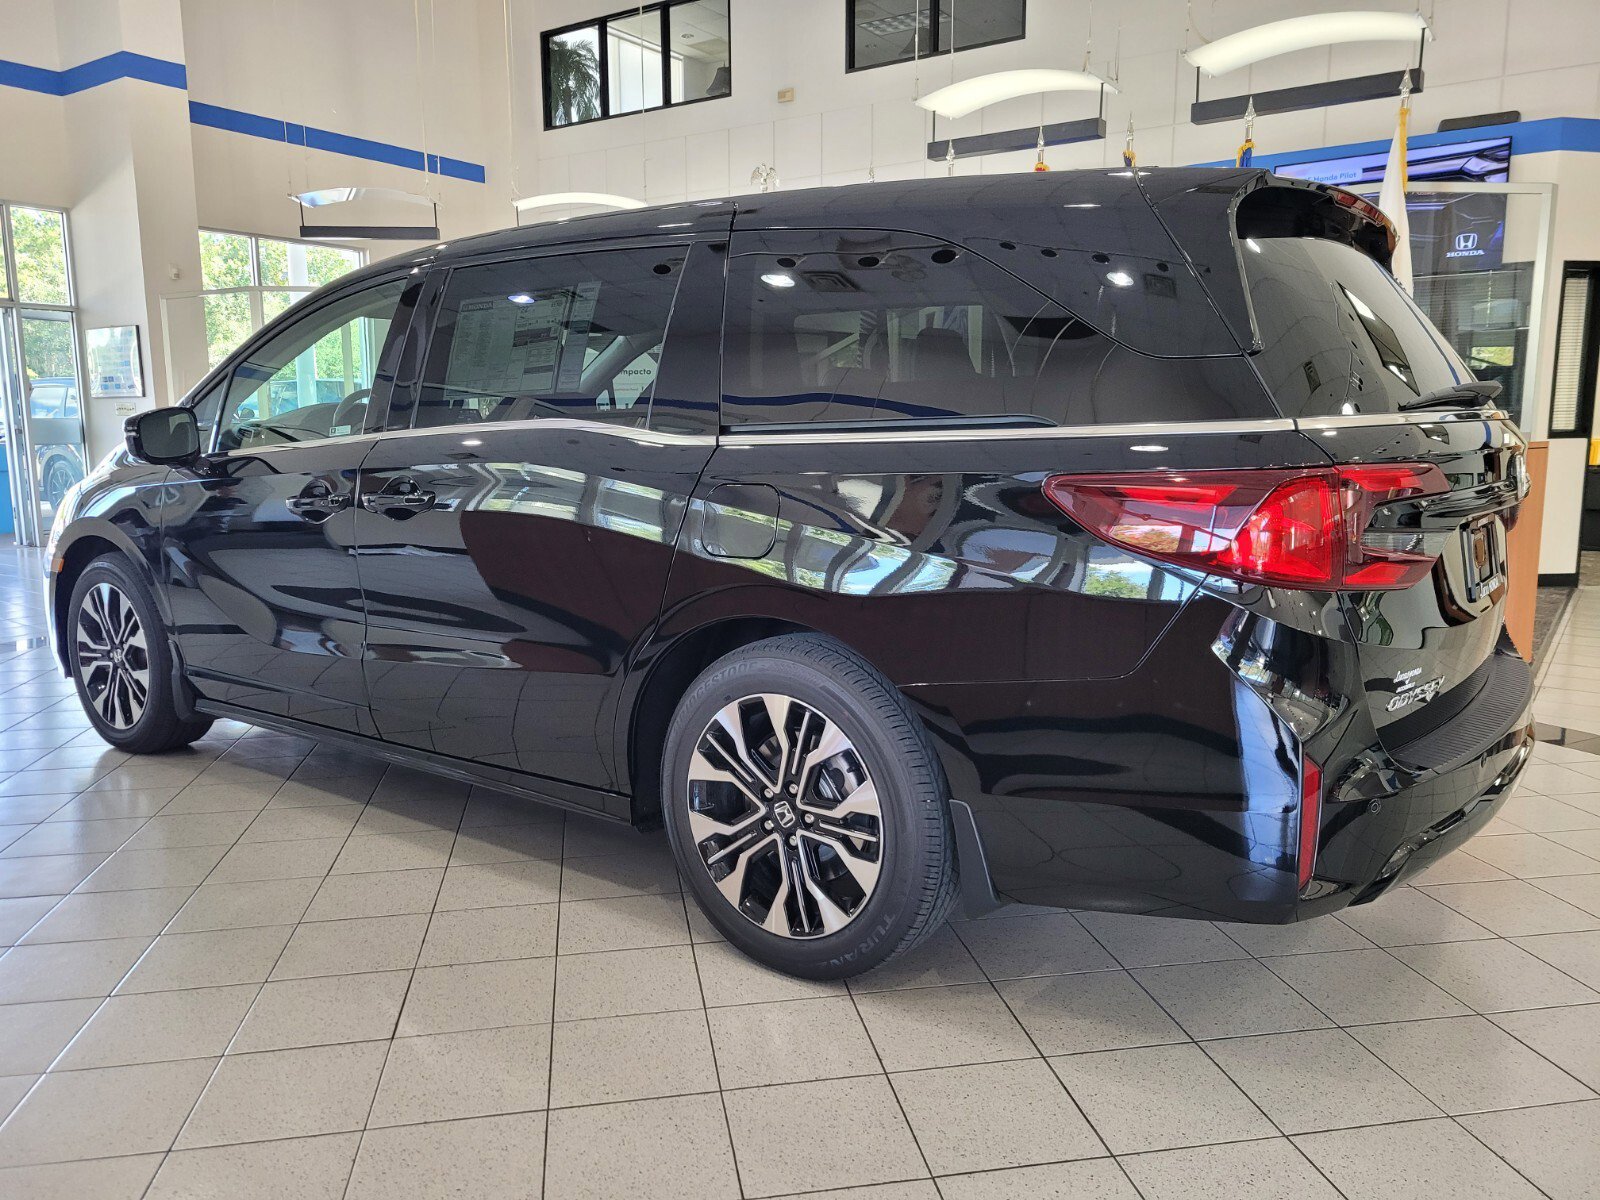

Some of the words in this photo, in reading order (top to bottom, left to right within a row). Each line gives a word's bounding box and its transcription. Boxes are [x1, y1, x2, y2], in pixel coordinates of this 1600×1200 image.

[1313, 173, 1338, 182] Honda
[1340, 171, 1357, 180] Pilot
[1446, 249, 1485, 258] HONDA
[620, 368, 652, 377] mpacto
[1387, 676, 1446, 711] ODYSSEY
